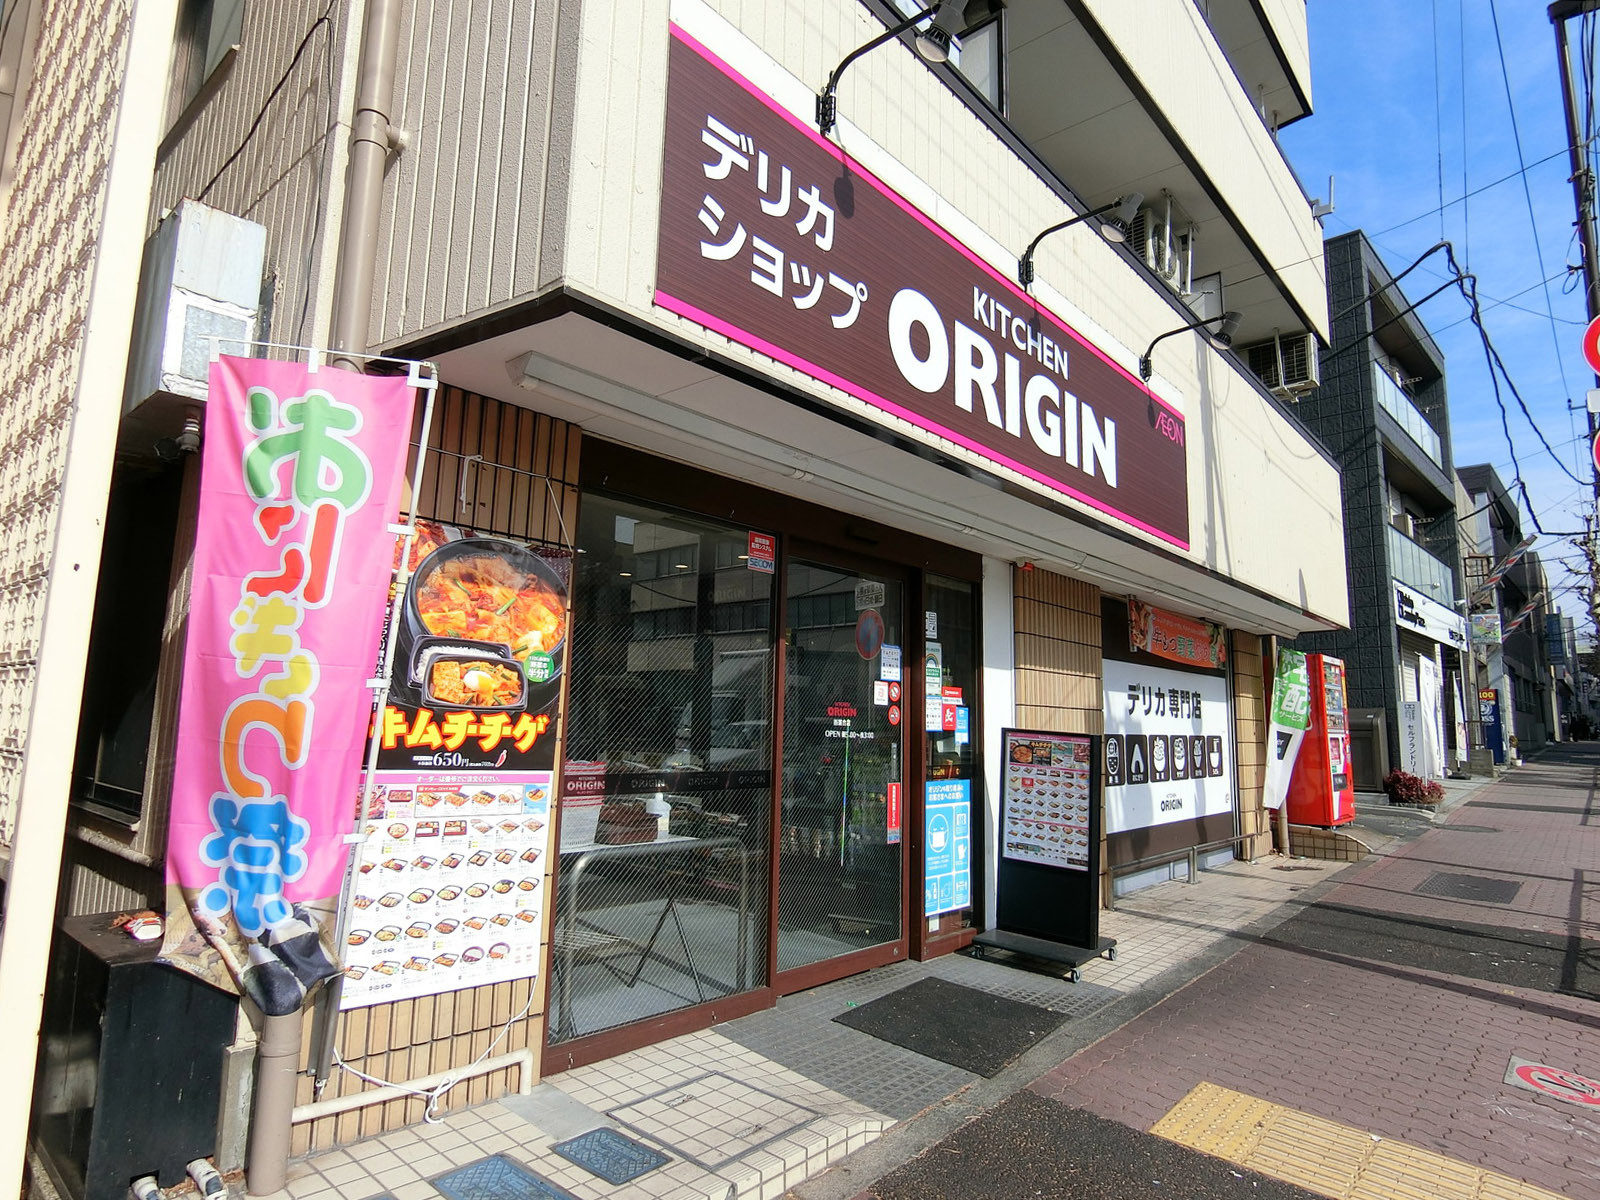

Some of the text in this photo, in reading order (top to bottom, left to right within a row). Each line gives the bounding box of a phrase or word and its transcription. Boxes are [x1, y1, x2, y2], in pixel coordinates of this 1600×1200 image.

[701, 114, 836, 252] デリカ
[698, 194, 869, 330] ショップ
[973, 286, 1069, 380] KITCHEN
[888, 287, 1118, 489] ORIGIN
[750, 557, 773, 570] SECOM
[827, 706, 857, 717] ORIGIN
[1127, 683, 1202, 719] デリカ専門店
[825, 730, 841, 738] OPEN
[567, 780, 606, 791] ORIGIN
[1161, 799, 1183, 812] ORIGIN
